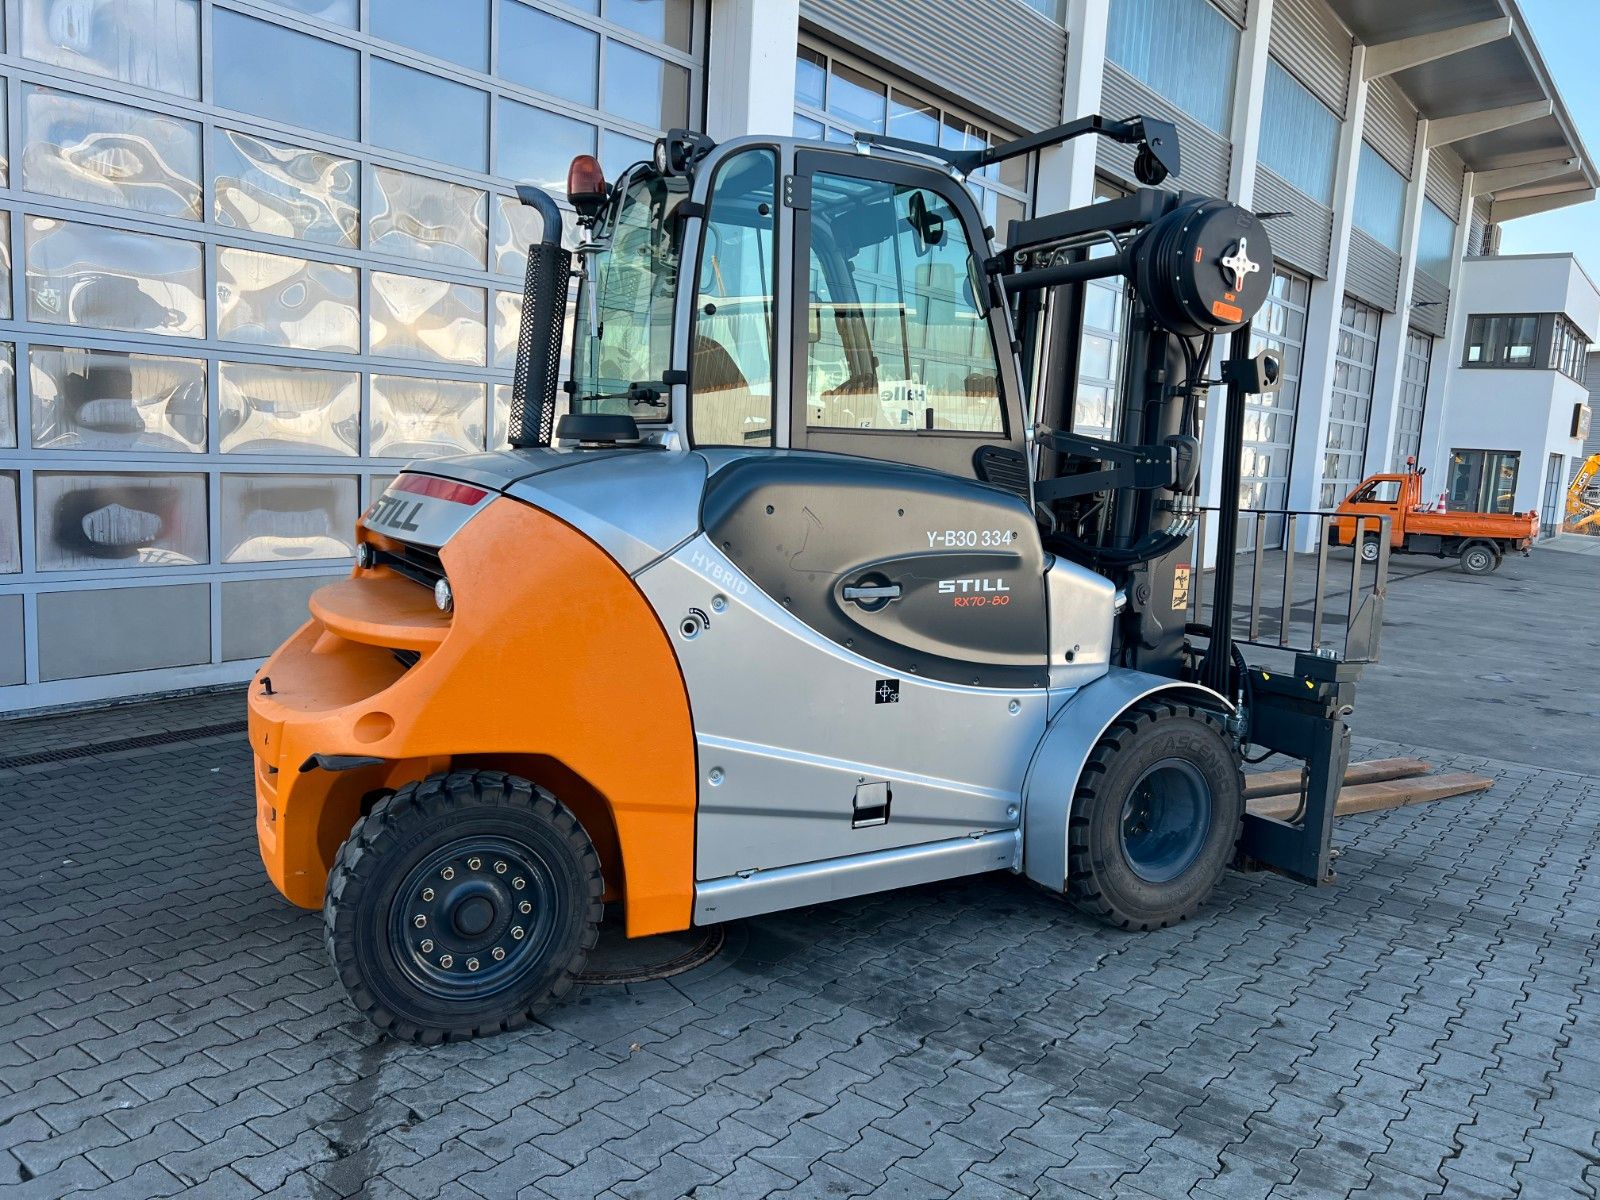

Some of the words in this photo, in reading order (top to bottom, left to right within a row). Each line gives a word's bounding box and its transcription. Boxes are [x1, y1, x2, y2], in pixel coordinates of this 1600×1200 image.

[1578, 473, 1588, 487] JCB
[367, 495, 423, 531] STILL
[926, 530, 977, 548] Y-B30
[981, 530, 1012, 546] 334
[691, 550, 748, 595] HYBRID
[938, 578, 1010, 594] STILL
